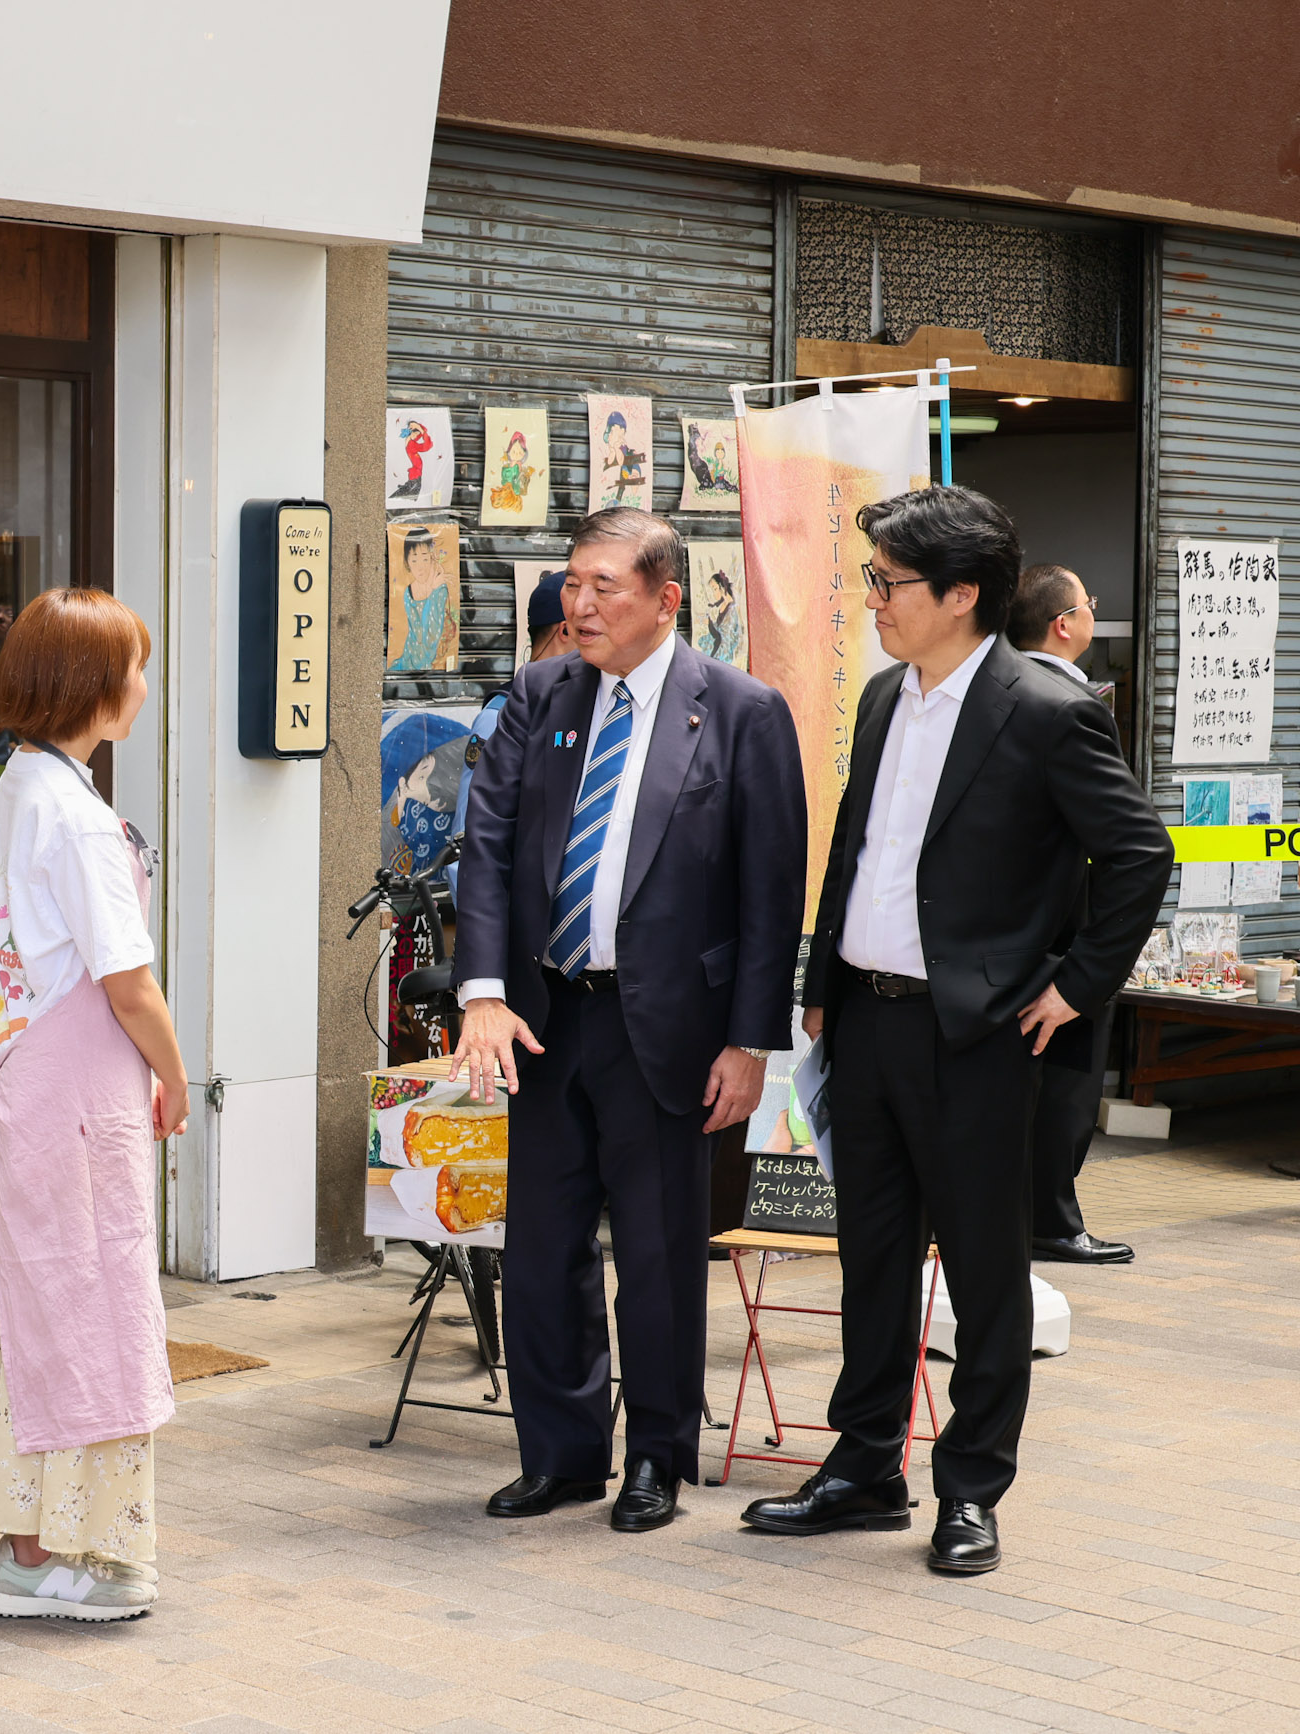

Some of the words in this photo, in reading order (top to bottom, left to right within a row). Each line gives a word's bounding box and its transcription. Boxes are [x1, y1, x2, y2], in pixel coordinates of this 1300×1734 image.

[285, 525, 311, 539] Come
[314, 527, 323, 539] In
[289, 545, 321, 557] We're
[290, 568, 314, 729] OPEN
[750, 1196, 837, 1219] ビタミンたっぷり
